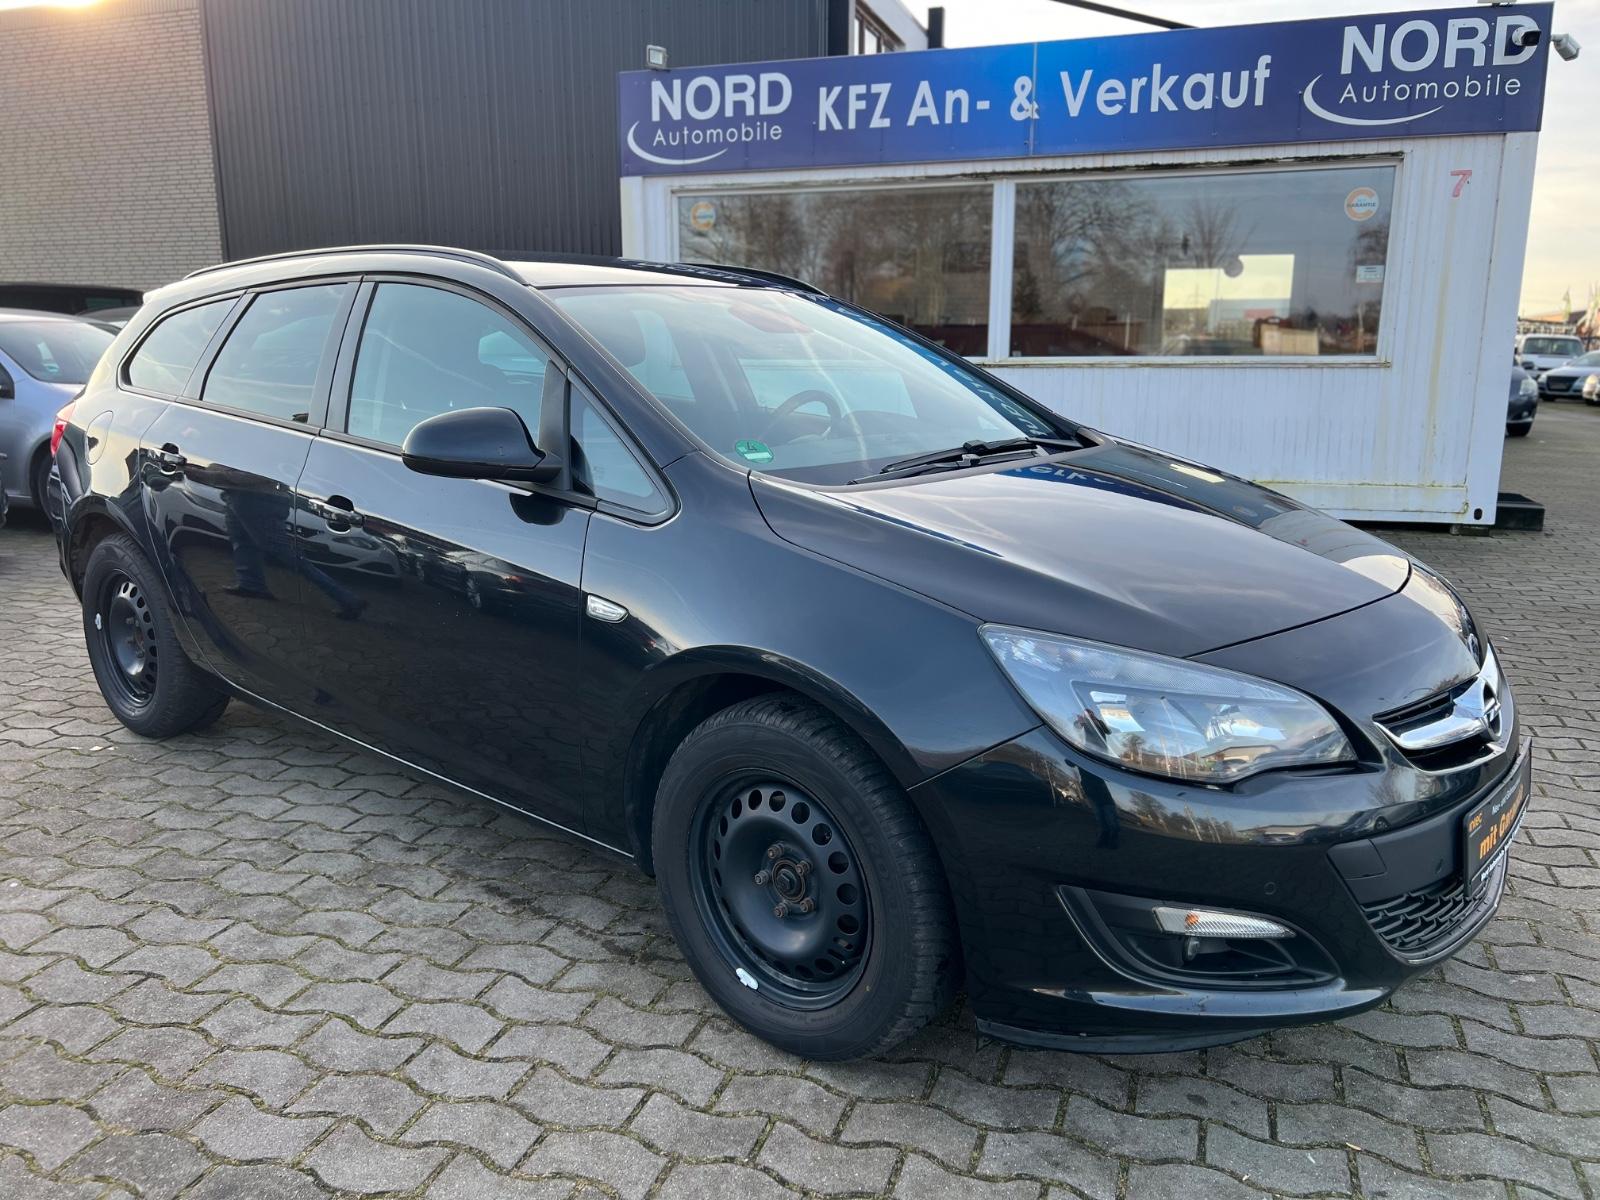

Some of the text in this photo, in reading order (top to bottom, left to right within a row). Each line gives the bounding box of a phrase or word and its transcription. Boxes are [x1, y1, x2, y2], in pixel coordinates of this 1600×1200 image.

[1340, 15, 1540, 75] NORD
[651, 72, 792, 122] NORD
[818, 54, 1271, 131] KFZ An- & Verkauf
[1339, 75, 1521, 104] Automobile
[653, 122, 782, 147] Automobile
[1450, 169, 1473, 198] 7
[1479, 824, 1498, 860] mit
